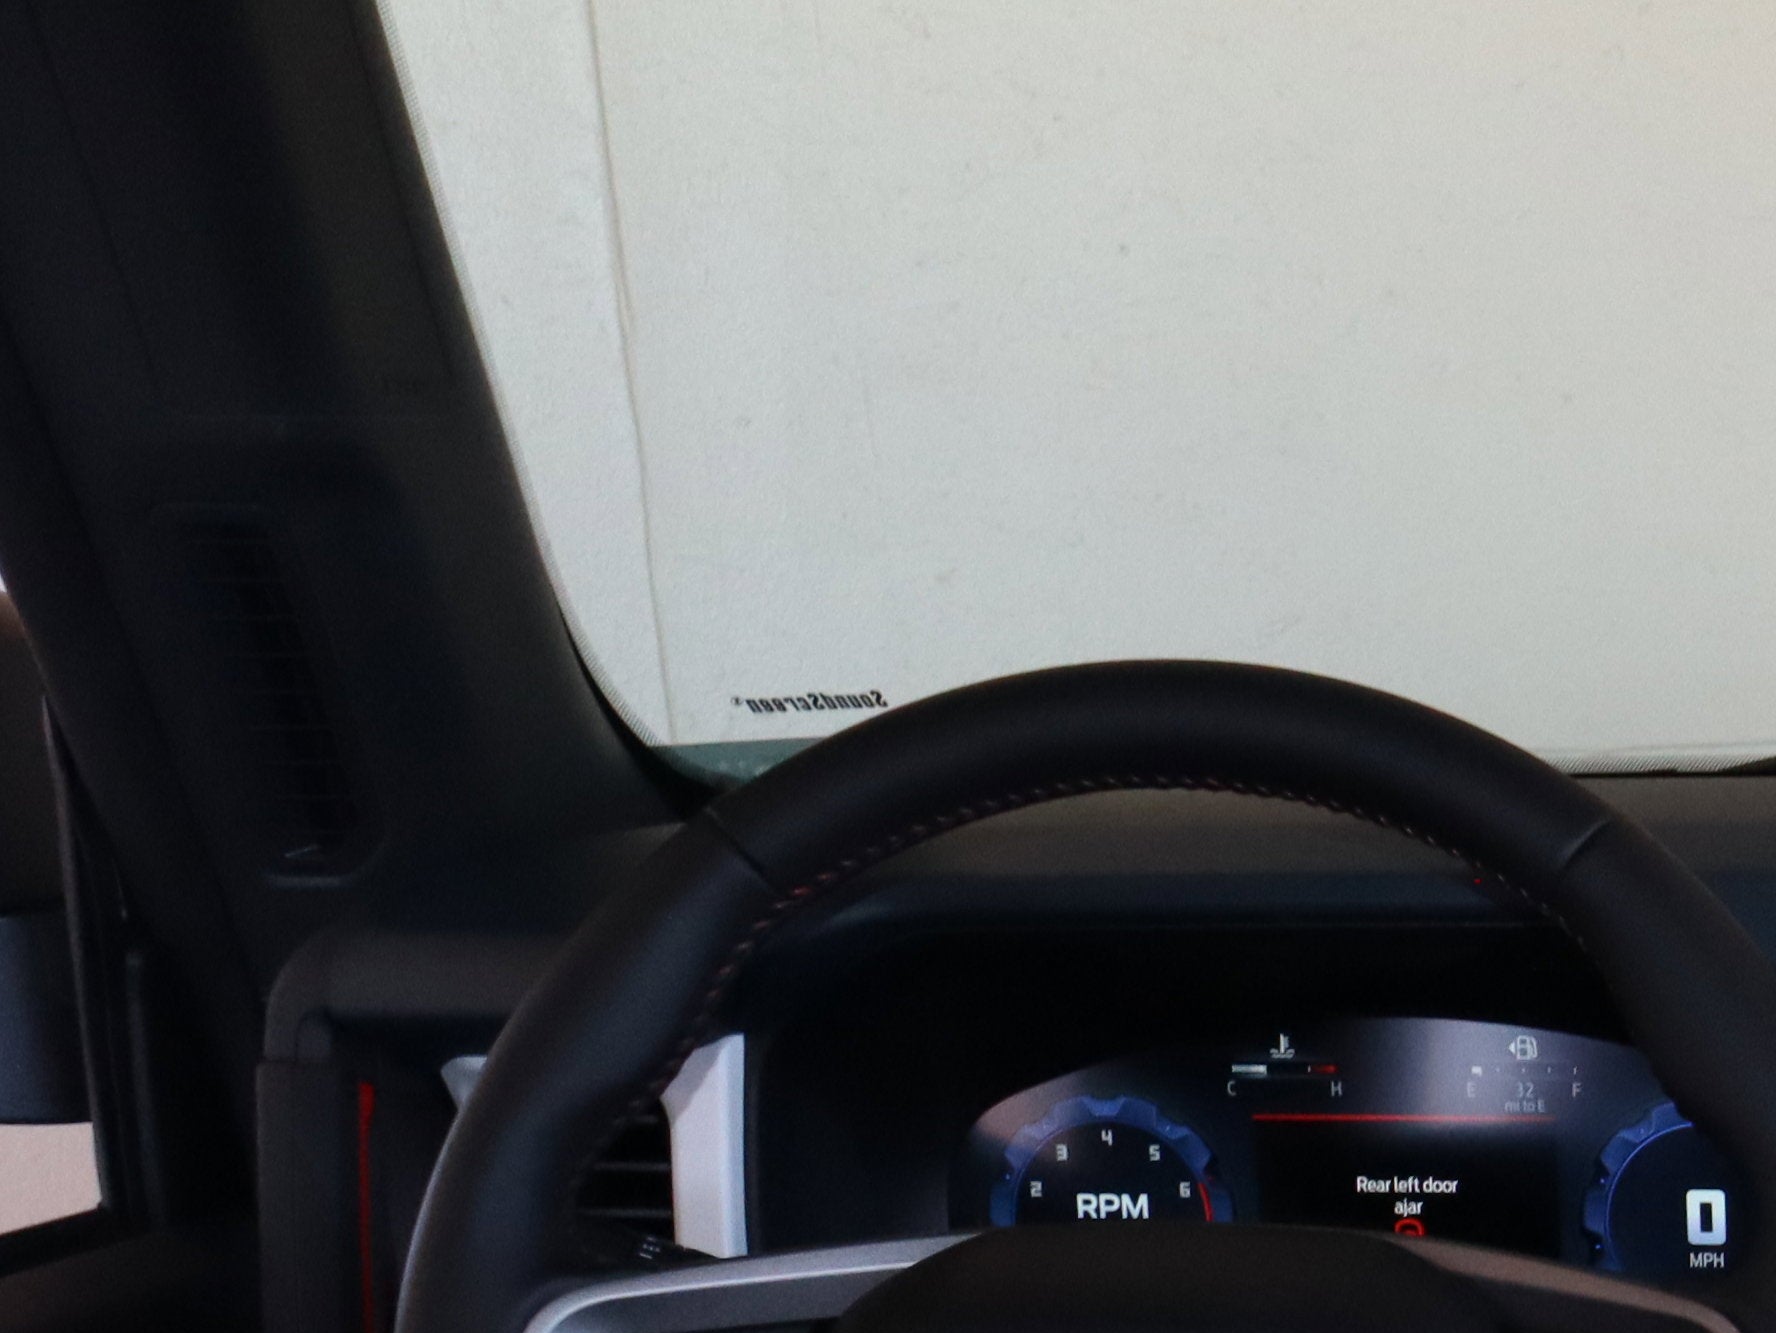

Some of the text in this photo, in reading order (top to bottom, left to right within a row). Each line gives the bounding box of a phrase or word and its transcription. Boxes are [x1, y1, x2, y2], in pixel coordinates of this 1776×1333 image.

[1227, 1081, 1237, 1097] C
[1331, 1081, 1343, 1097] H
[1467, 1082, 1477, 1097] E
[1517, 1082, 1534, 1098] 32
[1572, 1083, 1582, 1097] F
[1101, 1130, 1112, 1146] 4
[1056, 1144, 1068, 1161] 3
[1149, 1144, 1160, 1161] 5
[1030, 1181, 1042, 1197] 2
[1179, 1181, 1191, 1198] 6
[1357, 1176, 1458, 1193] Rear left door
[1076, 1192, 1149, 1220] RPM
[1394, 1200, 1423, 1216] ajar
[1686, 1189, 1727, 1246] 0
[1689, 1252, 1724, 1268] MPH
